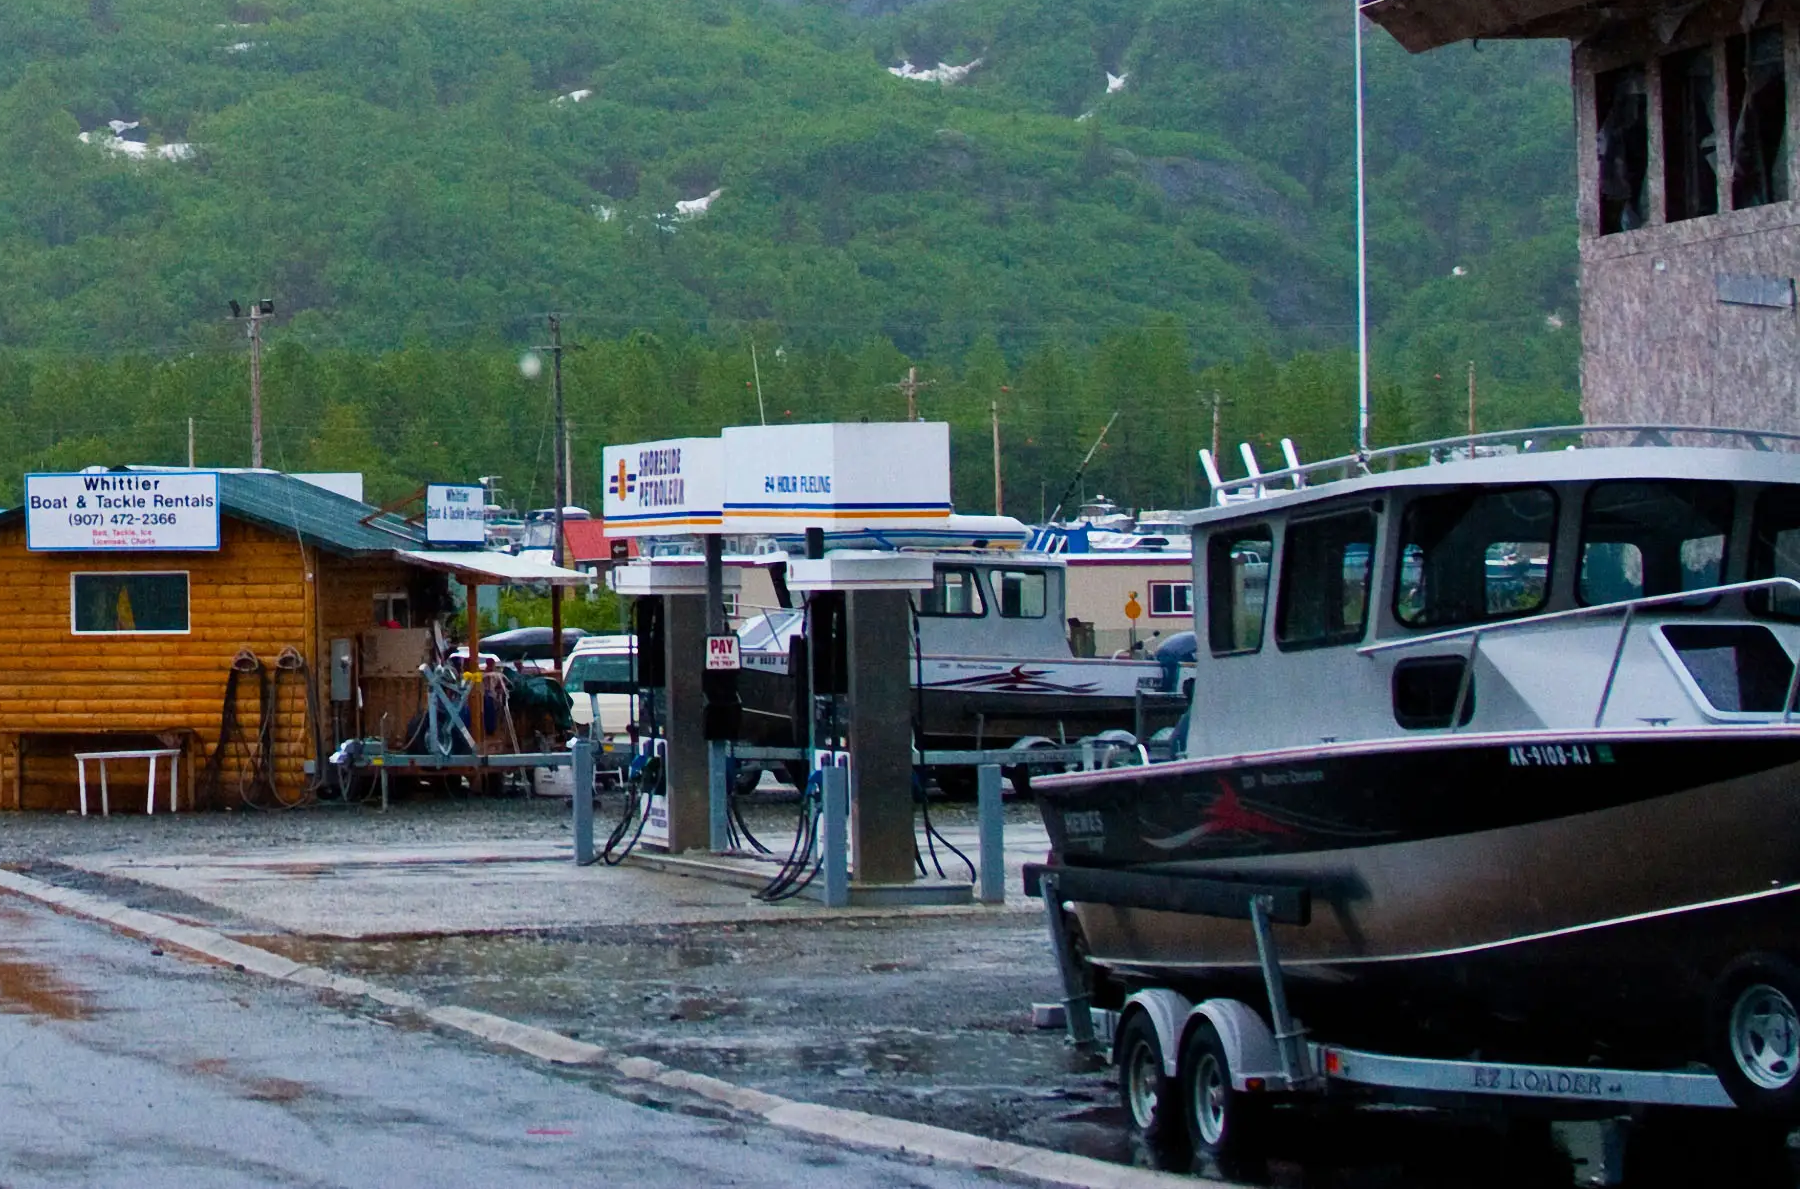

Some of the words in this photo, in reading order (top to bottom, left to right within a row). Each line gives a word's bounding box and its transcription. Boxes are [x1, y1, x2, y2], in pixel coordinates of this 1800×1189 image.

[638, 447, 681, 477] SHORESIDE
[84, 476, 160, 491] Whittier
[638, 477, 685, 507] PETROLEUM
[764, 475, 775, 493] 24
[777, 475, 797, 493] HOUR
[800, 475, 832, 494] FUELING
[30, 495, 68, 509] Boat
[76, 494, 87, 508] &
[96, 494, 146, 509] Tackle
[153, 493, 214, 508] Rentals
[68, 513, 104, 527] (907)
[110, 512, 177, 525] 472-2366
[710, 639, 734, 654] PAY
[1507, 1068, 1602, 1095] LOADER
